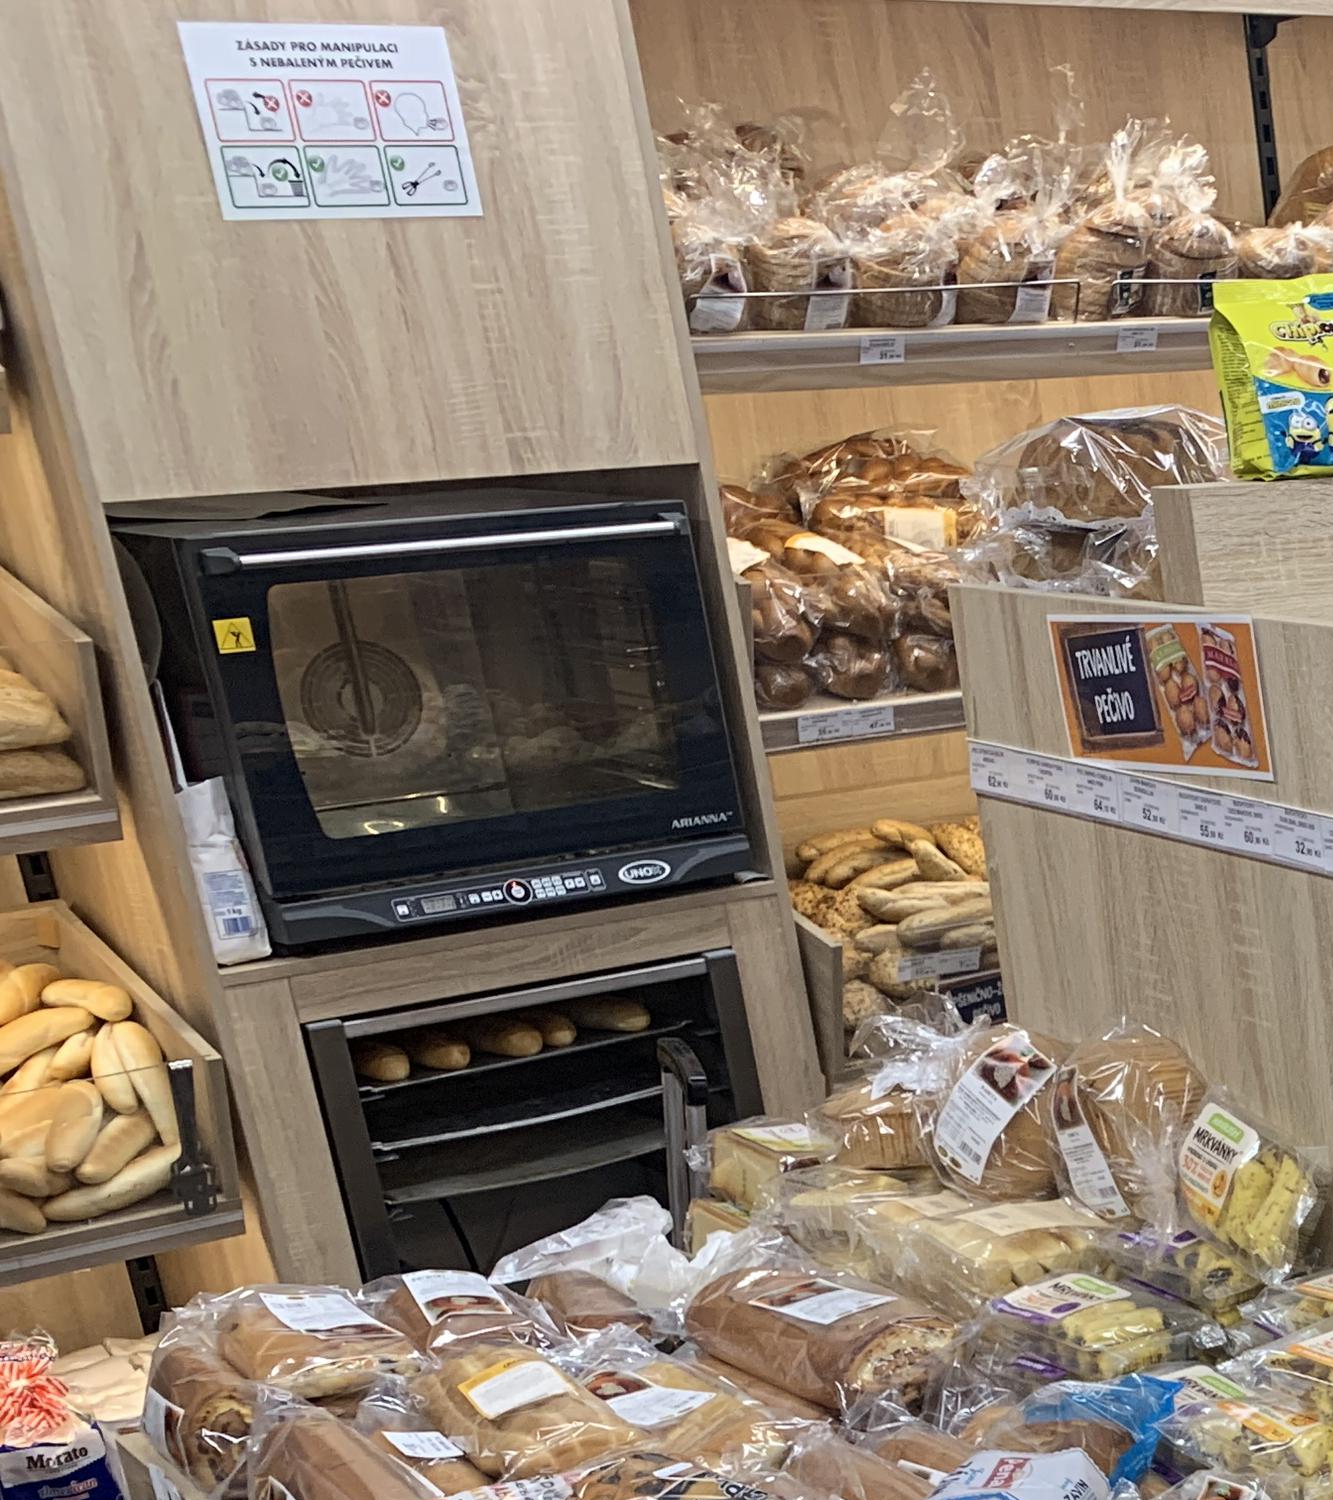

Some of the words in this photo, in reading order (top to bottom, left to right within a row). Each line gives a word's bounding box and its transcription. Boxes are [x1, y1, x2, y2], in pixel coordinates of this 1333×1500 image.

[235, 39, 286, 51] ZÁSADY
[290, 41, 317, 52] PRO
[321, 42, 399, 53] MANIPULACI
[249, 57, 257, 68] S
[260, 55, 338, 68] NEBALENÝM
[340, 55, 394, 69] PEČIVEM
[1075, 635, 1136, 680] TRVANLIVÉ
[1094, 688, 1134, 724] PEČIVO
[672, 813, 728, 830] ARIANNA
[1193, 1127, 1238, 1163] MRKVANKY
